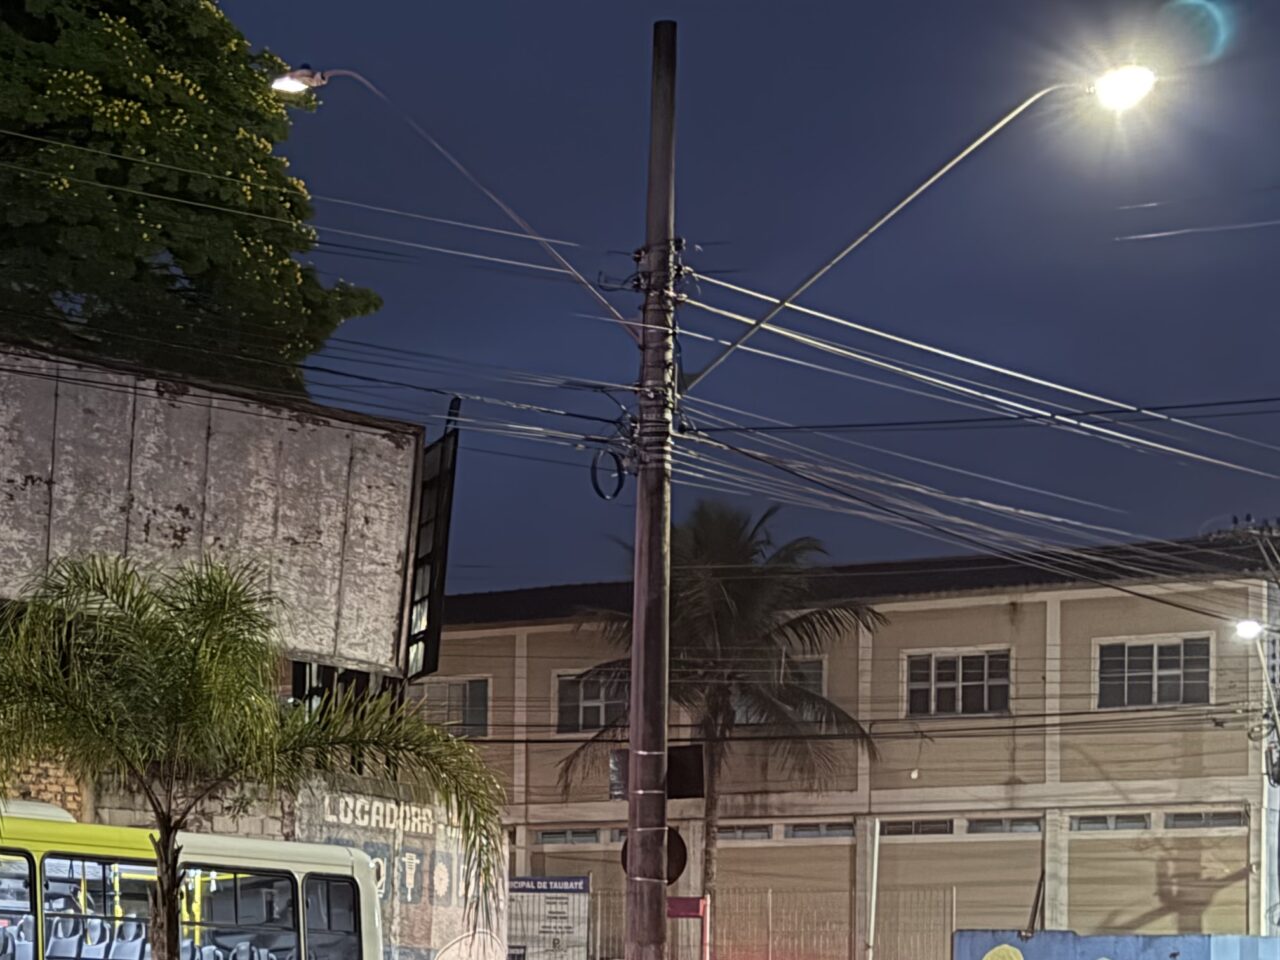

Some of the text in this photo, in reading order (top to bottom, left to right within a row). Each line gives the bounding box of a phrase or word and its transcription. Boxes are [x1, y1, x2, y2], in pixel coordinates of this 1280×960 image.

[323, 794, 434, 834] LOCADORA
[537, 881, 548, 889] DE
[549, 879, 584, 890] TAUBATÉ
